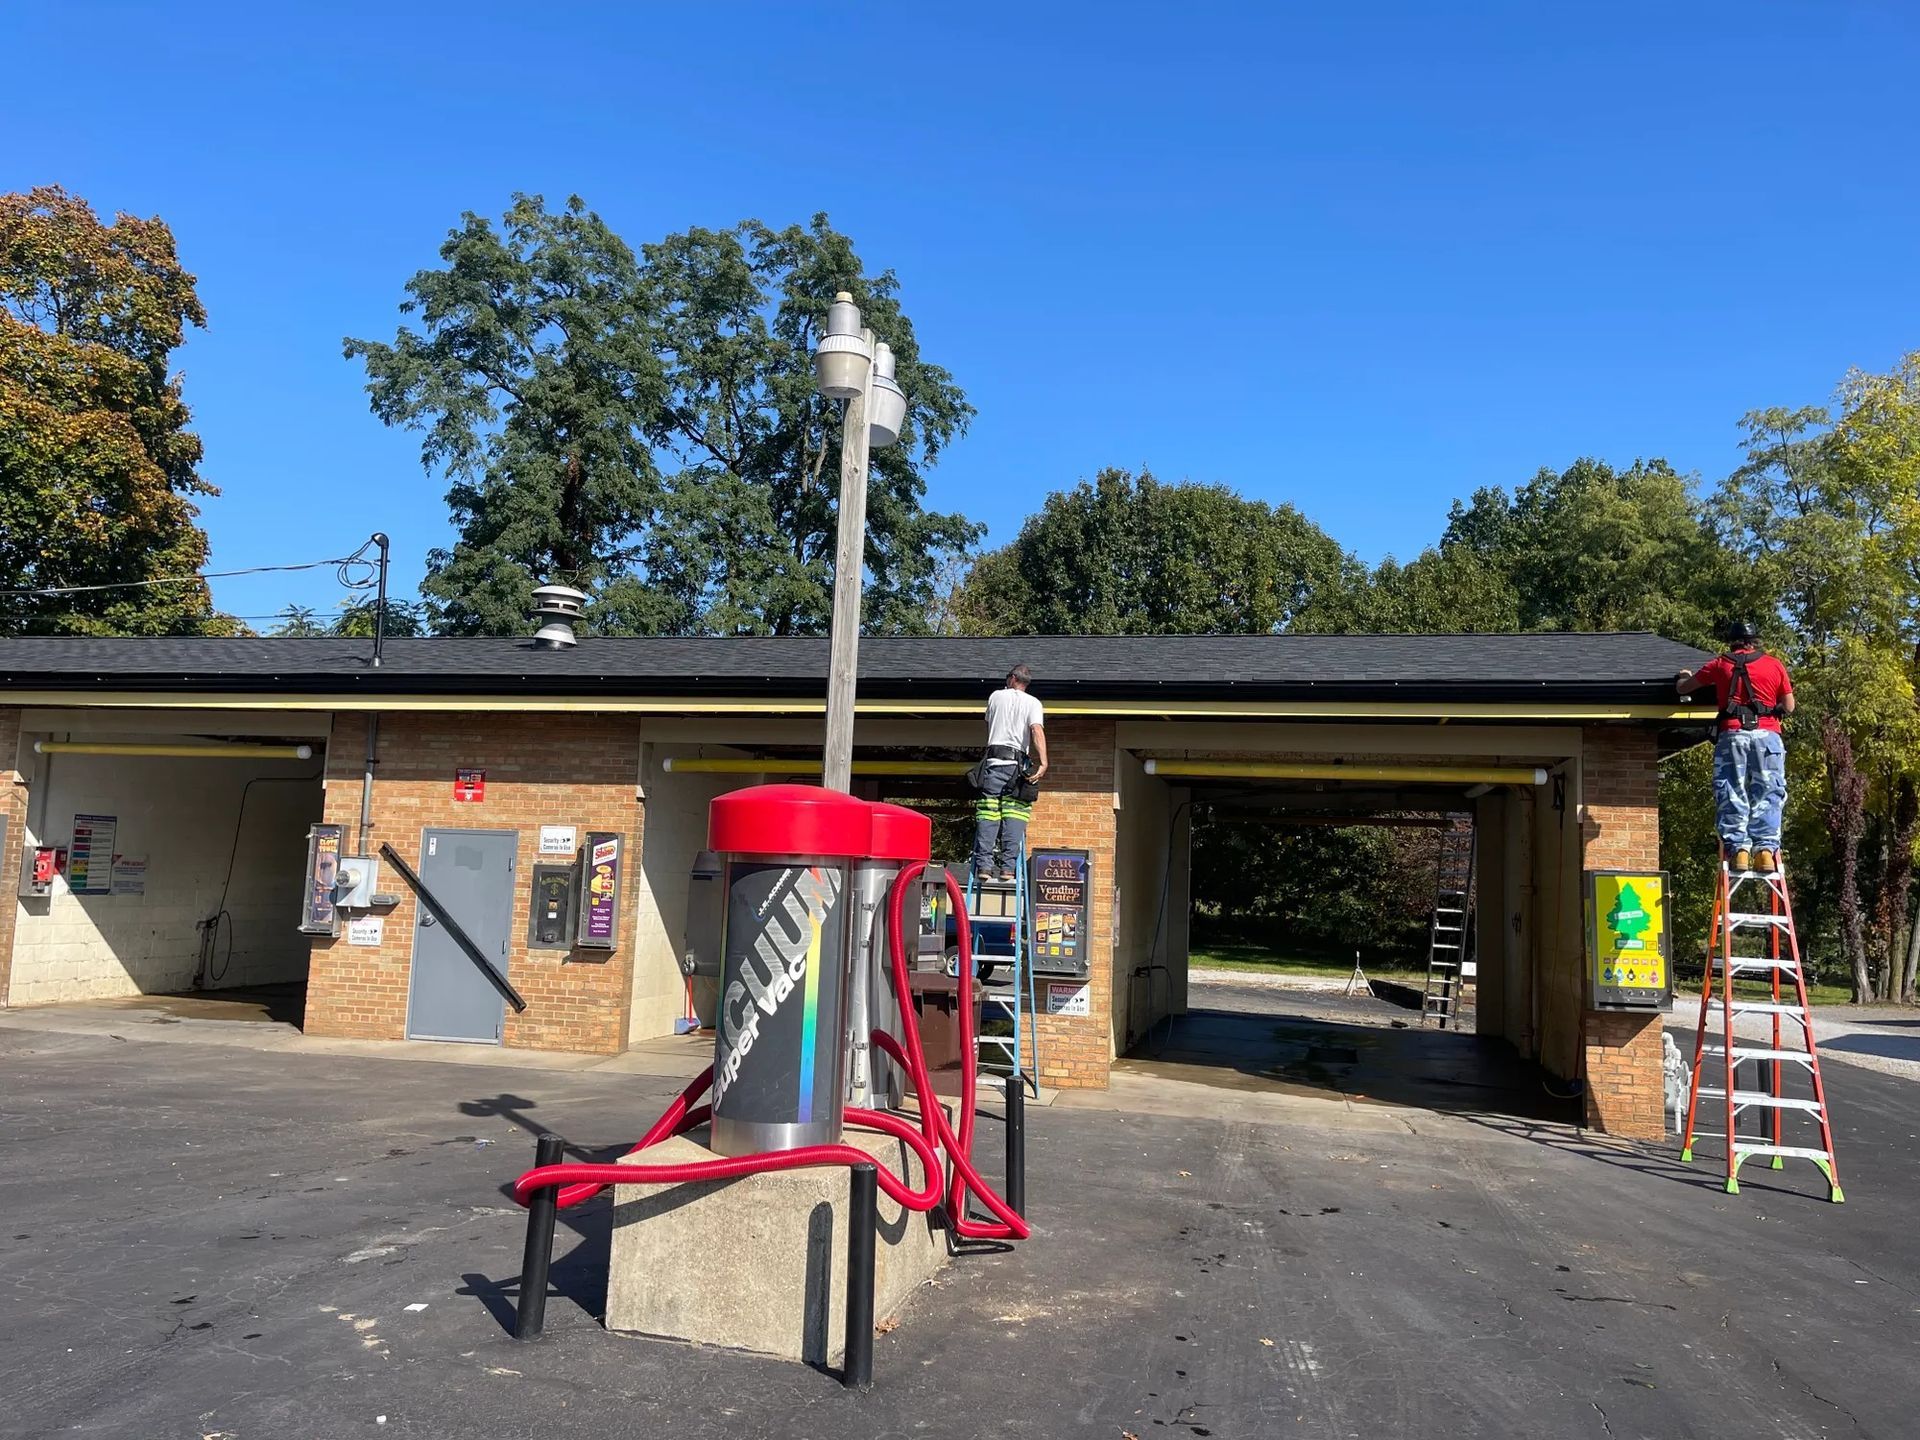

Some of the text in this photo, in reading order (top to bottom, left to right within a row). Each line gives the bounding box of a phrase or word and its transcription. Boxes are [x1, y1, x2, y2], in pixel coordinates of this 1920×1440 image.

[1048, 859, 1072, 868] CAR
[1044, 868, 1076, 879] CARE
[1039, 884, 1080, 898] Vending
[1044, 893, 1076, 902] Center
[1051, 986, 1078, 994] WARNIN
[713, 1011, 760, 1112] Super
